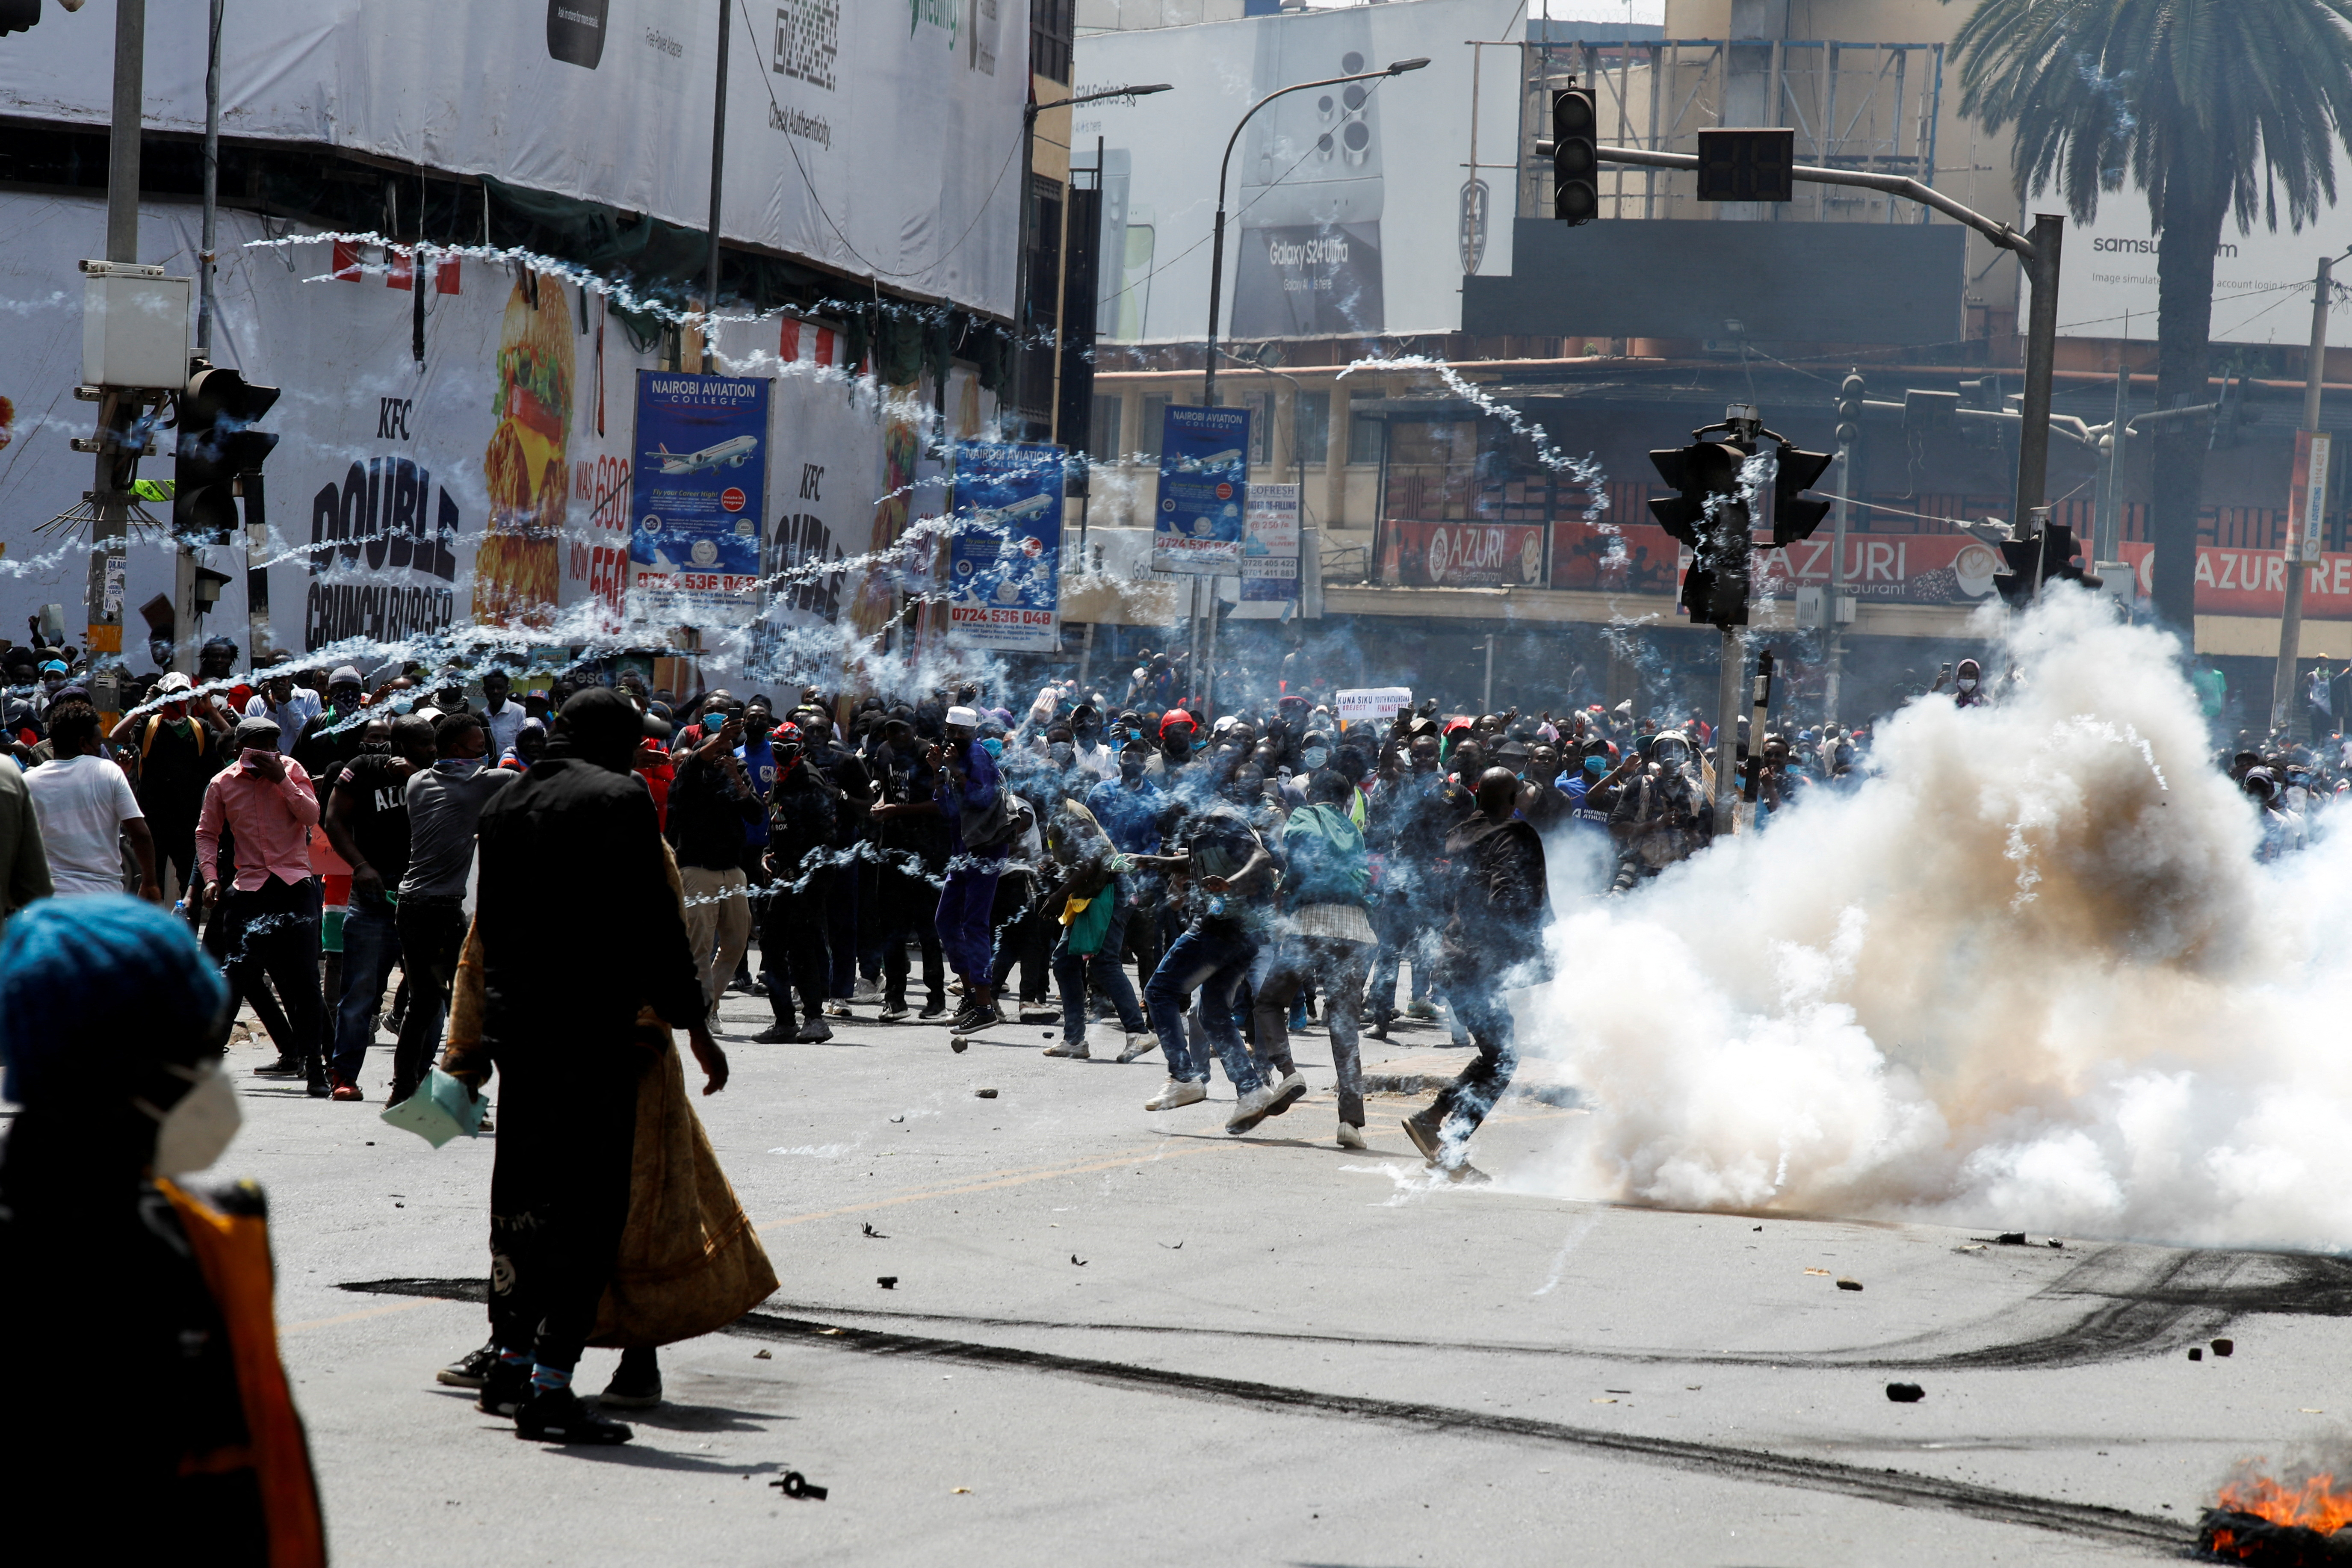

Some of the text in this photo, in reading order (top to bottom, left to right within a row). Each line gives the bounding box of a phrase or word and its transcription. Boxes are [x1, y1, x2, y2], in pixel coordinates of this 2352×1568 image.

[646, 27, 683, 60] Free Power Adapter
[769, 100, 830, 151] Check Authenticity.
[1270, 239, 1348, 271] Galaxy S24 Ultra
[1284, 278, 1303, 294] Galaxy
[1303, 278, 1308, 289] AI
[1319, 278, 1331, 289] here
[2092, 273, 2120, 284] Image
[2123, 275, 2160, 284] simulate
[2217, 280, 2251, 289] account
[2255, 280, 2277, 290] login
[2281, 281, 2287, 289] is
[653, 381, 755, 397] NAIROBI AVIATION
[672, 395, 736, 405] COLLEGE
[377, 397, 412, 440] KFC
[1173, 411, 1242, 423] NAIROBI AVIATION
[966, 448, 1004, 460] NAIROBI
[576, 454, 629, 531] WAS 690
[799, 463, 824, 502] KFC
[1249, 486, 1294, 495] EOFRESH
[309, 456, 459, 582] DOUBLE
[1449, 529, 1504, 568] AZURI
[766, 513, 847, 626] OUBLE
[1761, 541, 1905, 581] AZURI
[2194, 553, 2284, 592] AZUR
[570, 542, 589, 581] NOW
[590, 546, 628, 635] 550
[686, 574, 718, 590] 536
[305, 582, 453, 653] CRUNCH BURGER
[952, 608, 1051, 625] 0724 536 048
[1338, 696, 1355, 704] KUNA
[1358, 696, 1372, 704] SIKU
[1377, 704, 1396, 712] FINANCE
[1583, 814, 1607, 822] ATHLETE
[1584, 809, 1608, 817] INFINITE
